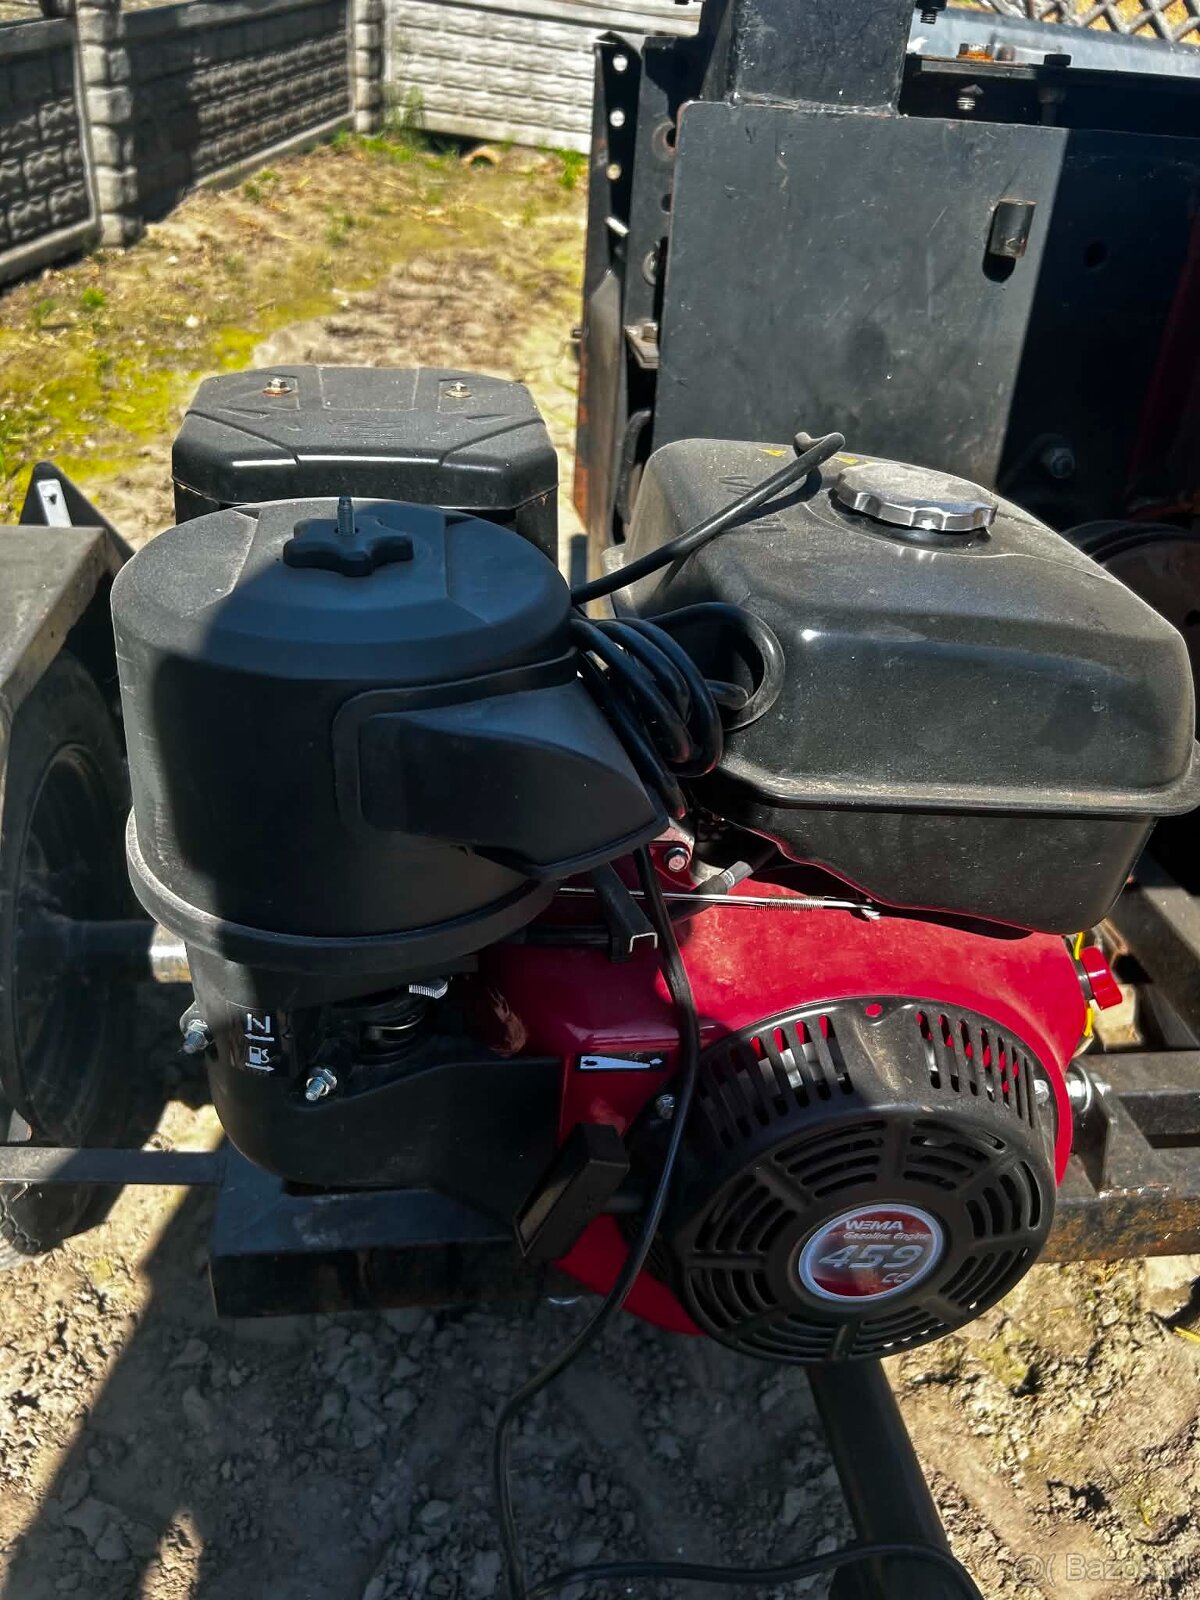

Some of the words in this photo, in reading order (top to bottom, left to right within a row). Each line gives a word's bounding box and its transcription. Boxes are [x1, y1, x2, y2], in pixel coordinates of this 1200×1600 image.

[845, 1220, 903, 1230] WEMA
[843, 1231, 890, 1240] Gasoline
[893, 1232, 932, 1241] Engine
[818, 1244, 924, 1268] 459
